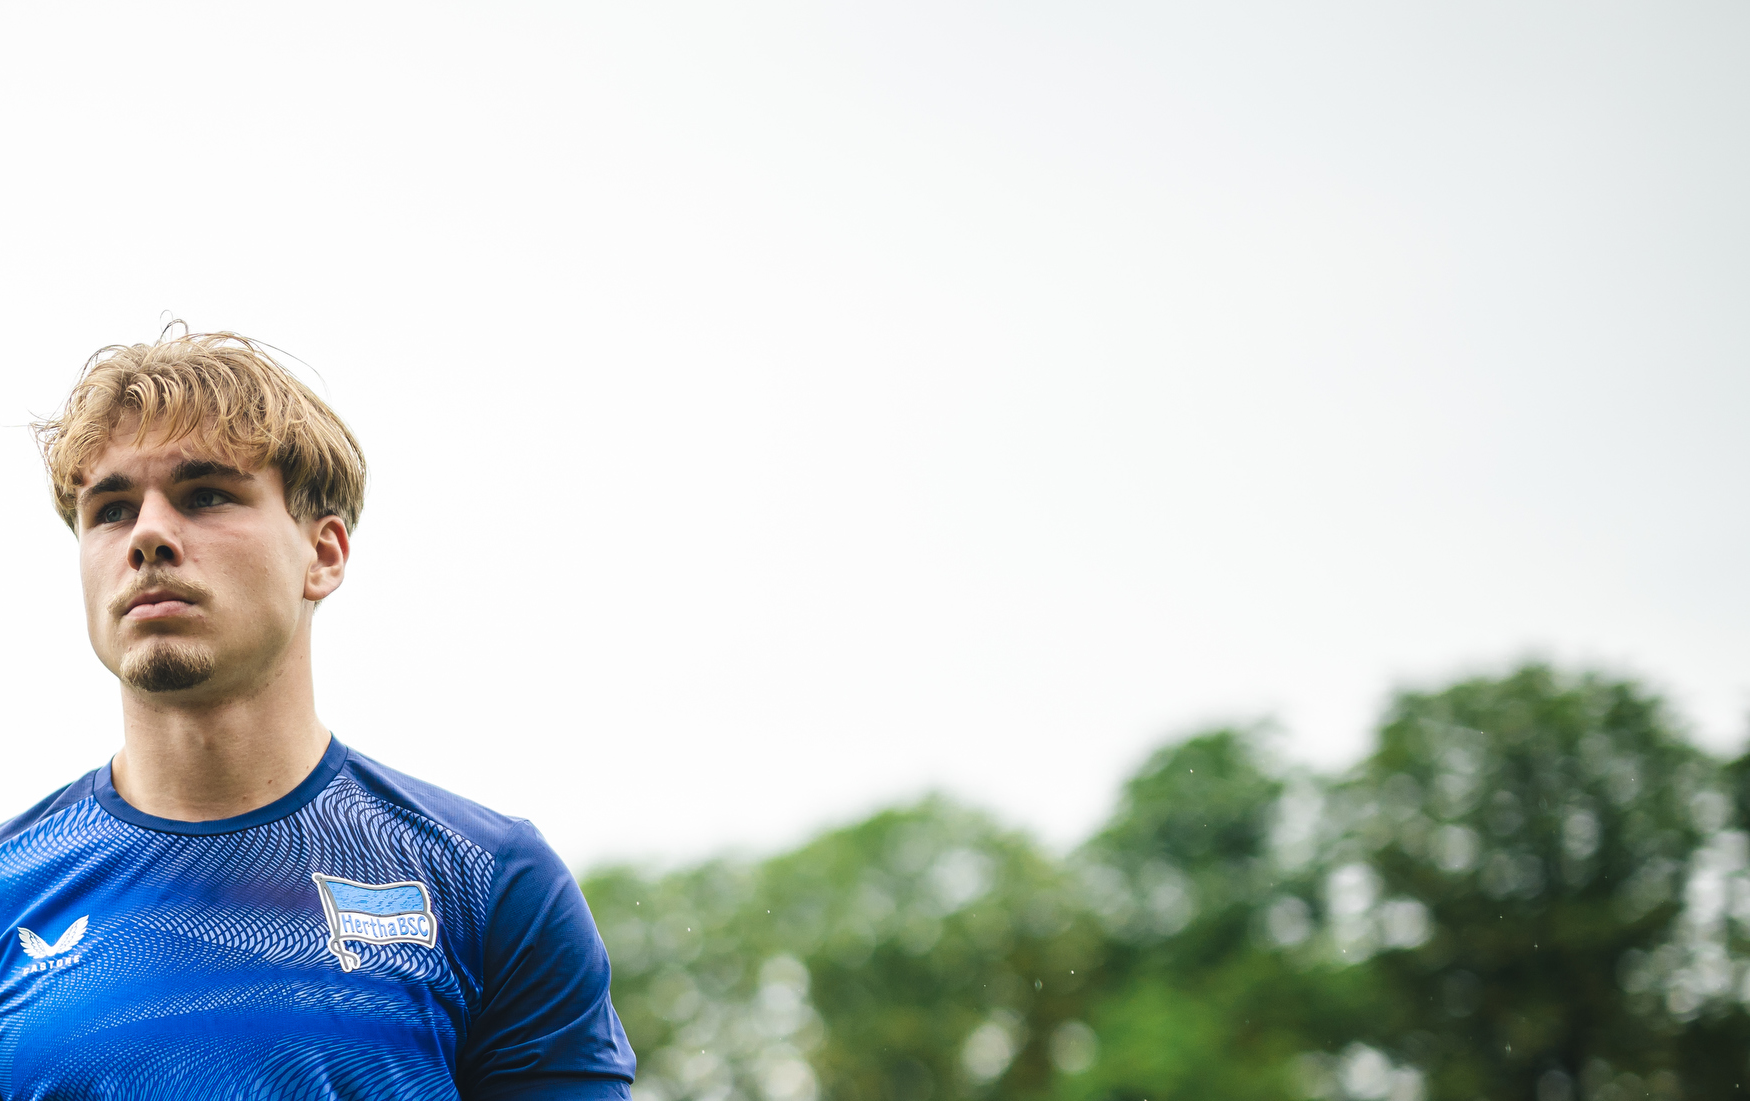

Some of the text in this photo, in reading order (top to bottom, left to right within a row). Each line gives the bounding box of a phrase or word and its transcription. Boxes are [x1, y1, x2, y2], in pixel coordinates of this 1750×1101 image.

[341, 914, 429, 938] Hertha BSC
[23, 955, 80, 975] CASTORE
